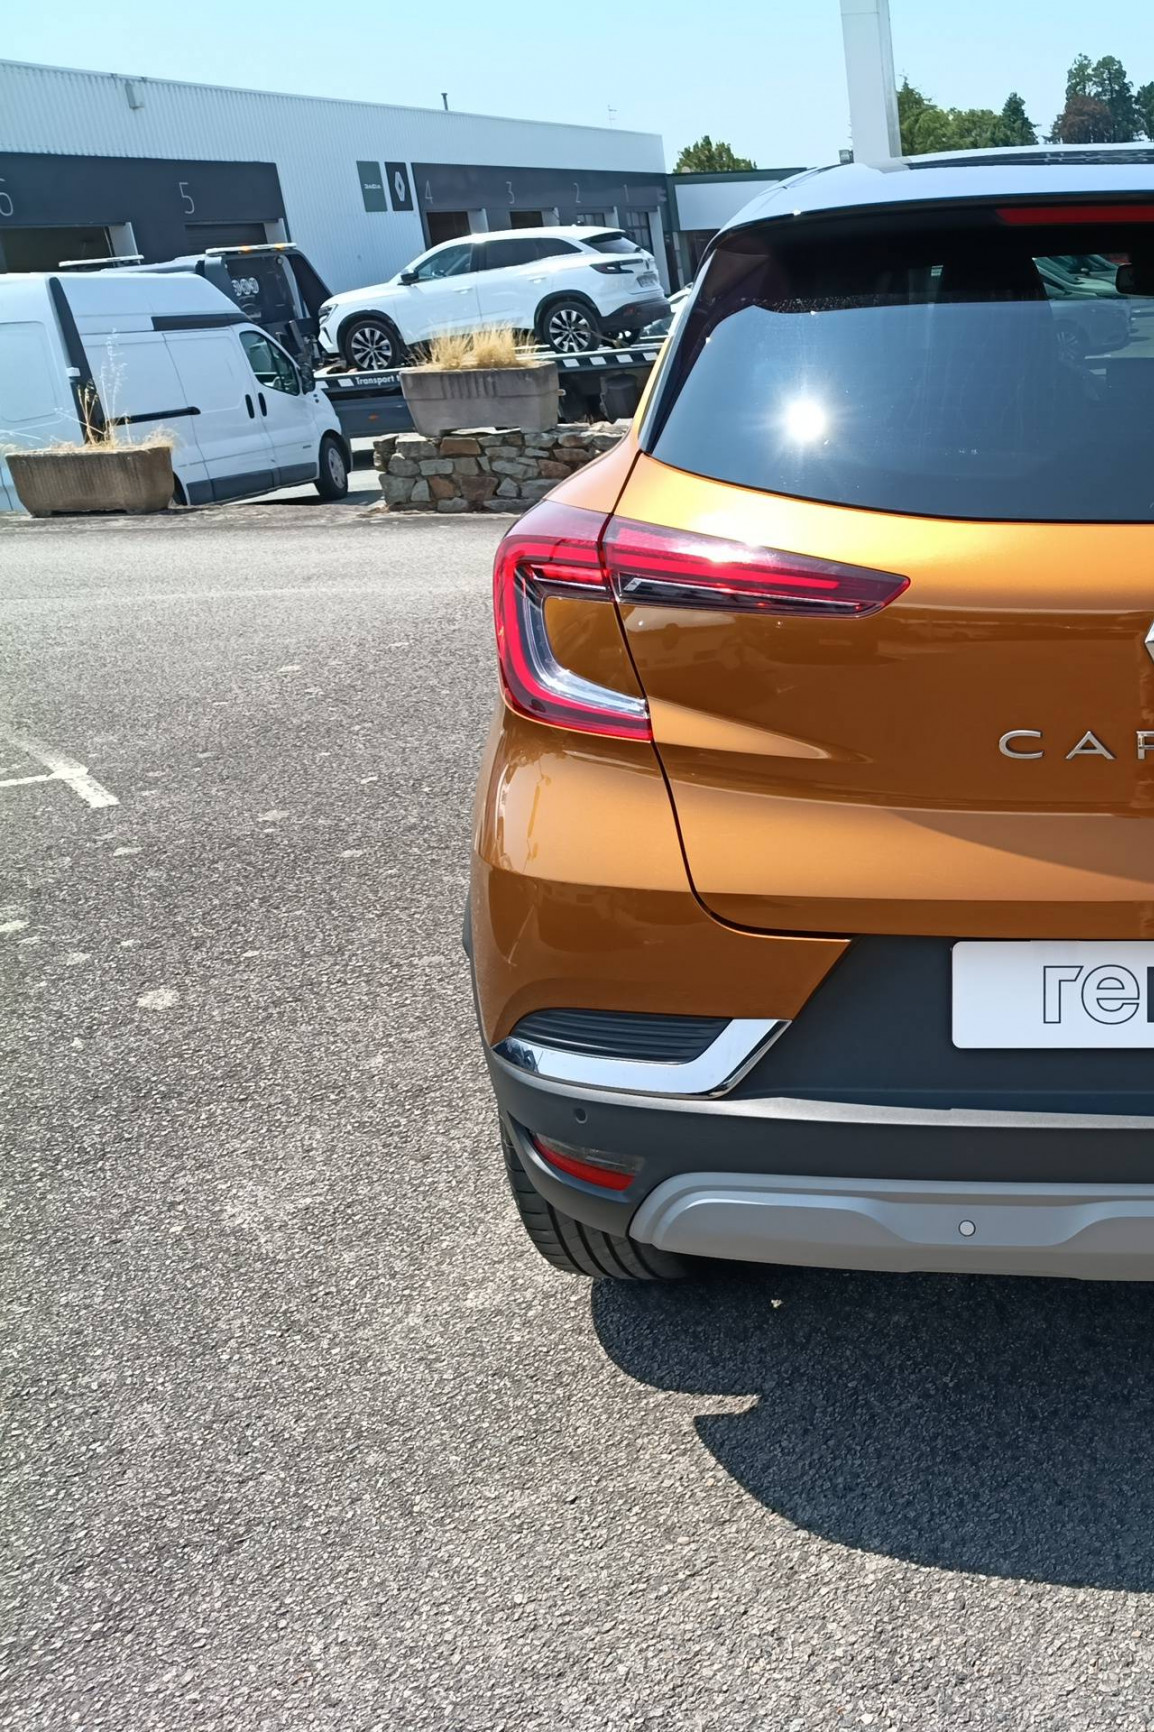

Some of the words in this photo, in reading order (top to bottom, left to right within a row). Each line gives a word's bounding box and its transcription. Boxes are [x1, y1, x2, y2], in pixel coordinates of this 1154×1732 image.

[179, 182, 195, 214] 5
[424, 180, 433, 204] 4
[506, 181, 515, 204] 3
[573, 182, 581, 203] 2
[355, 374, 395, 386] Transport
